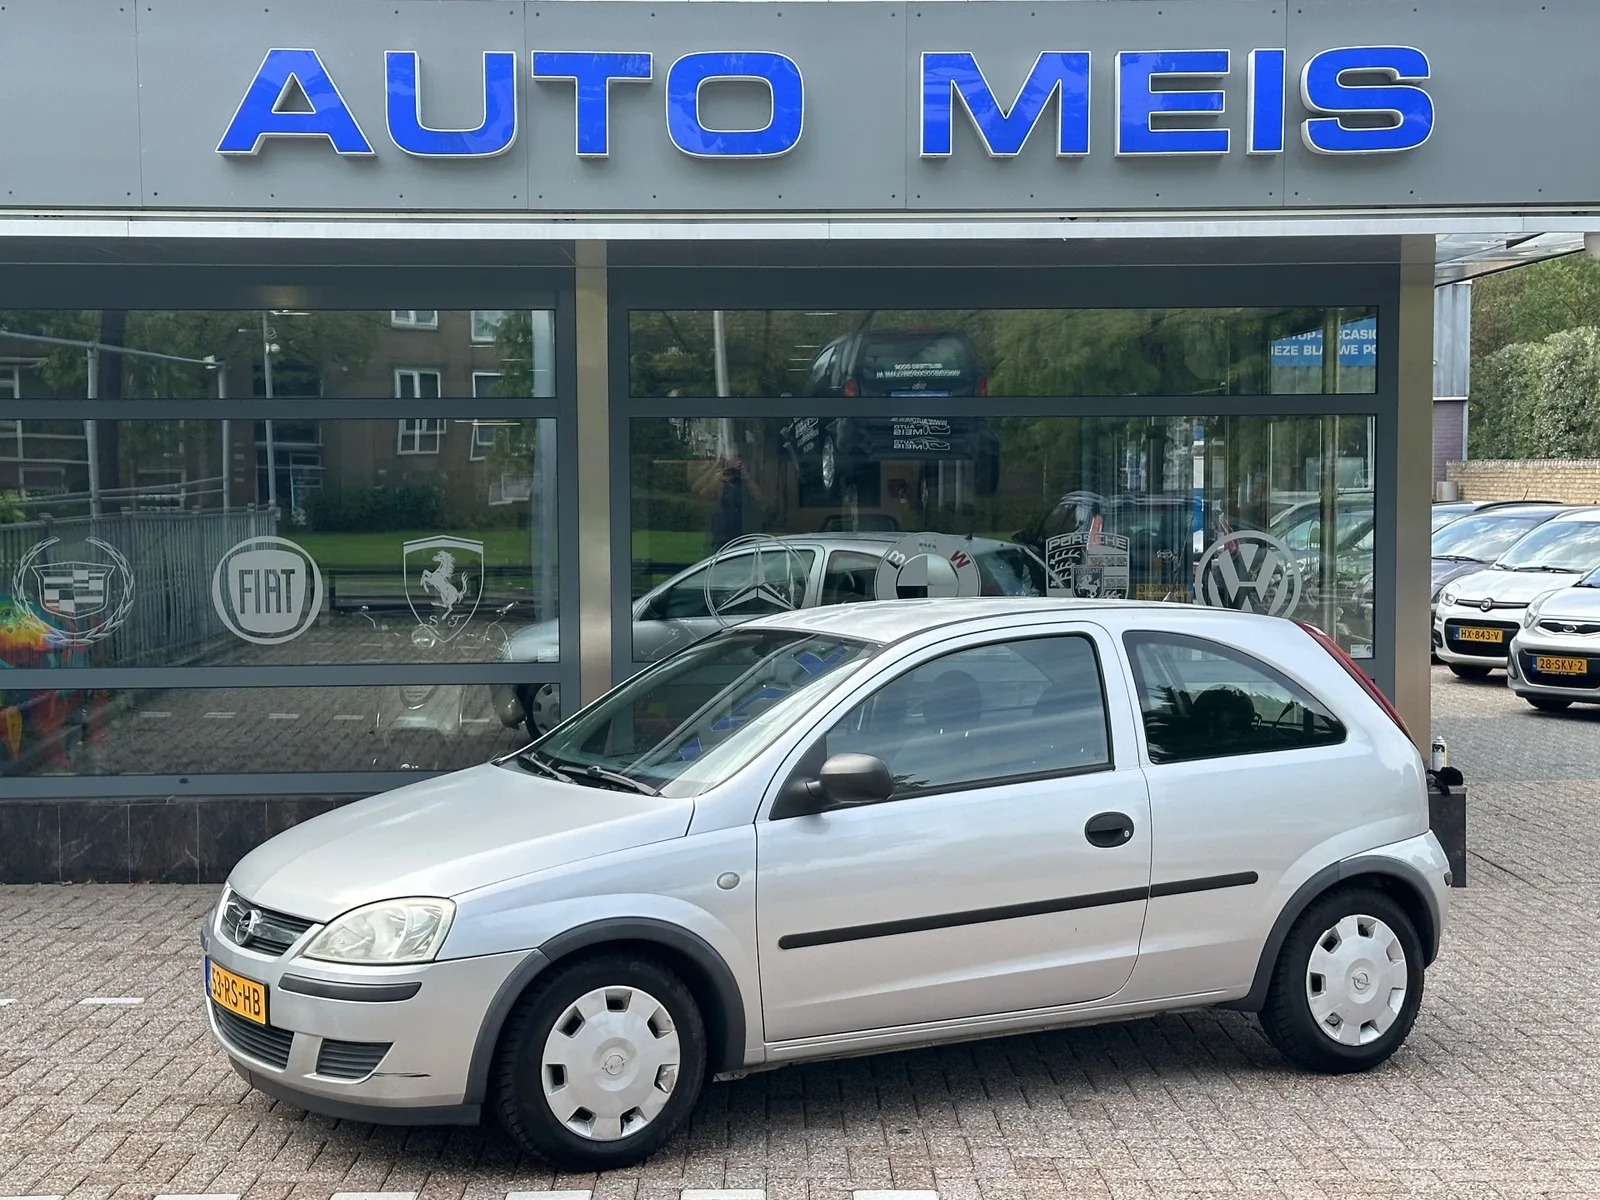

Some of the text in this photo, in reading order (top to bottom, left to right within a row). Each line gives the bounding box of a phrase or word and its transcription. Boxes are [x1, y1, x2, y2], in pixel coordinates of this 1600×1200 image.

[215, 45, 1436, 160] AUTO MEIS
[1271, 345, 1299, 356] EZE
[1048, 534, 1128, 552] PORSCHE
[238, 568, 296, 614] FIAT
[211, 966, 261, 1017] 53-RS-HB
